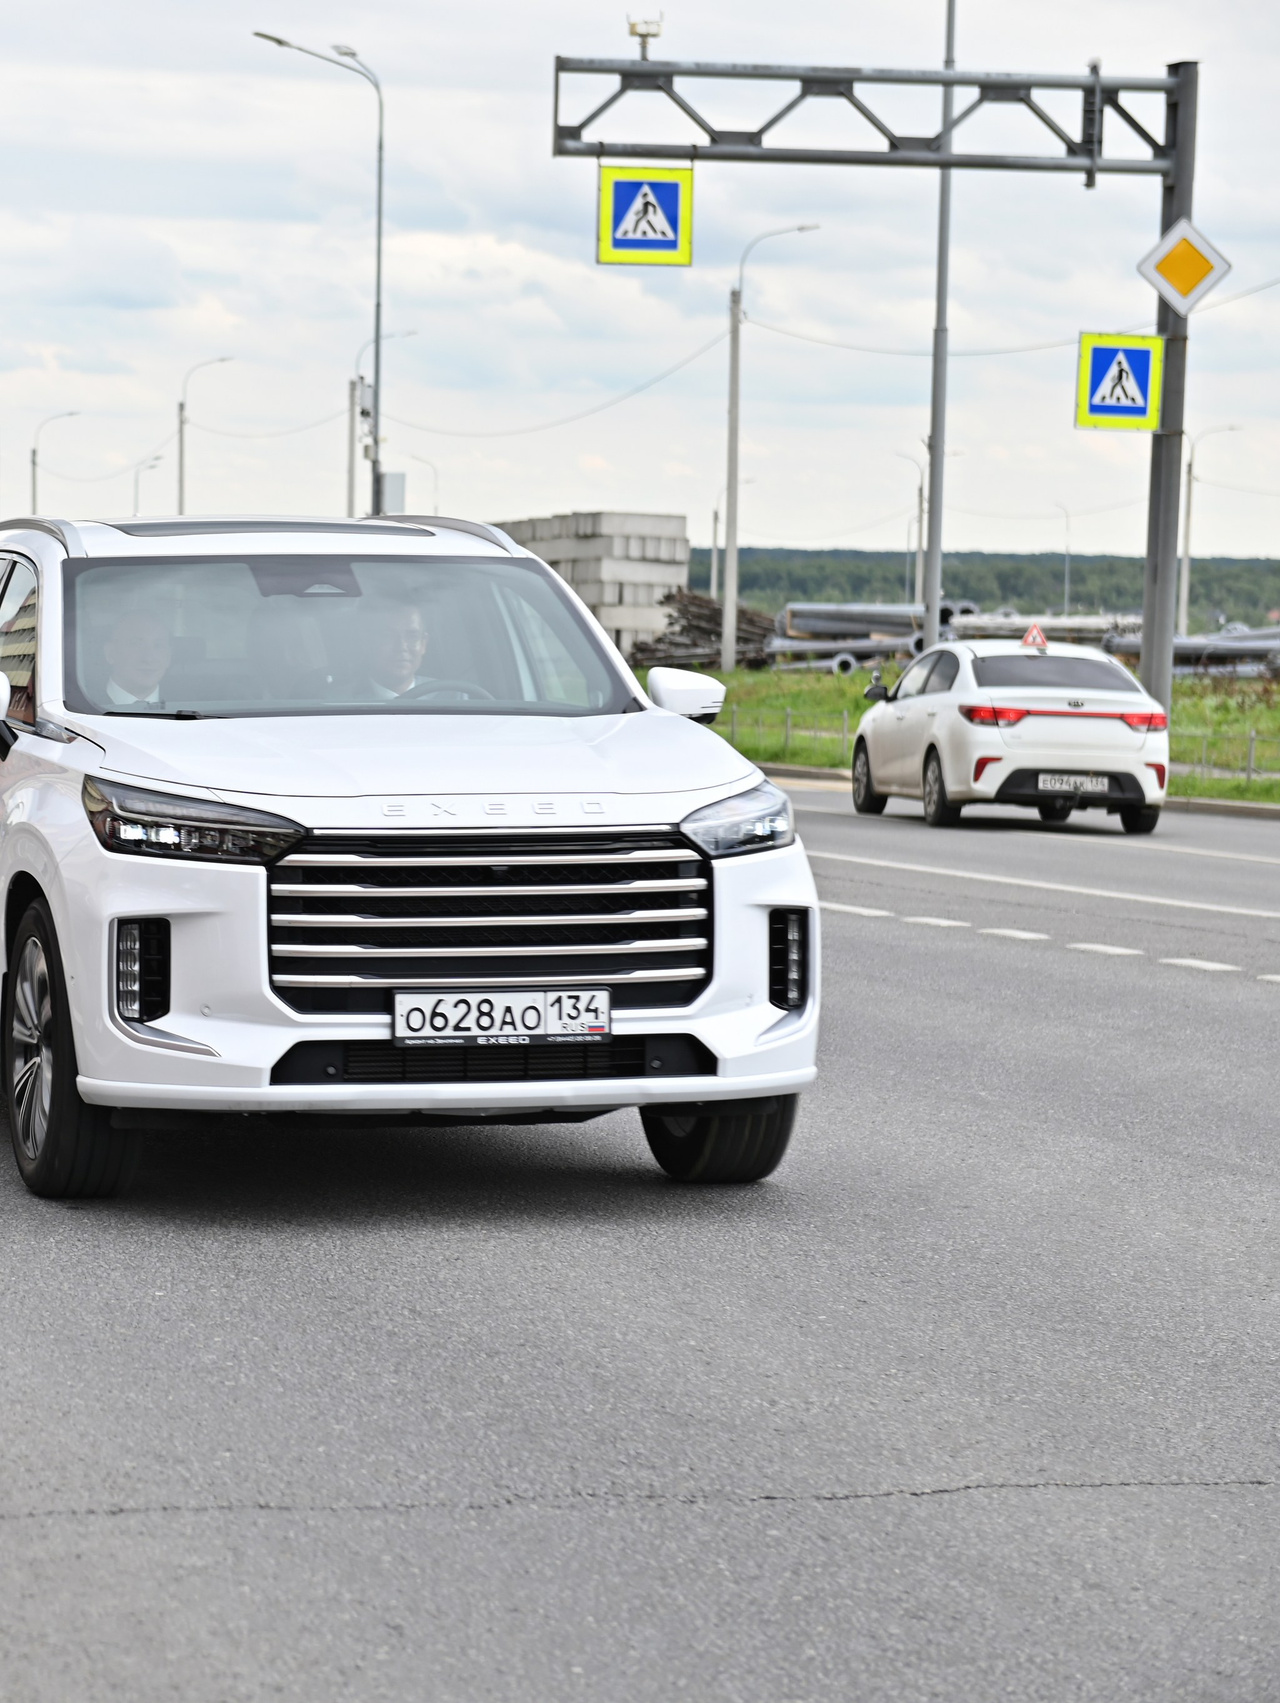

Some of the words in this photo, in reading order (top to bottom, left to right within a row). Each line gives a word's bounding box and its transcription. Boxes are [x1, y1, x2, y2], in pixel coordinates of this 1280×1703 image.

[382, 801, 606, 816] EXEED
[549, 994, 600, 1021] 134
[561, 1022, 587, 1032] RUS
[476, 1036, 530, 1045] EXEED
